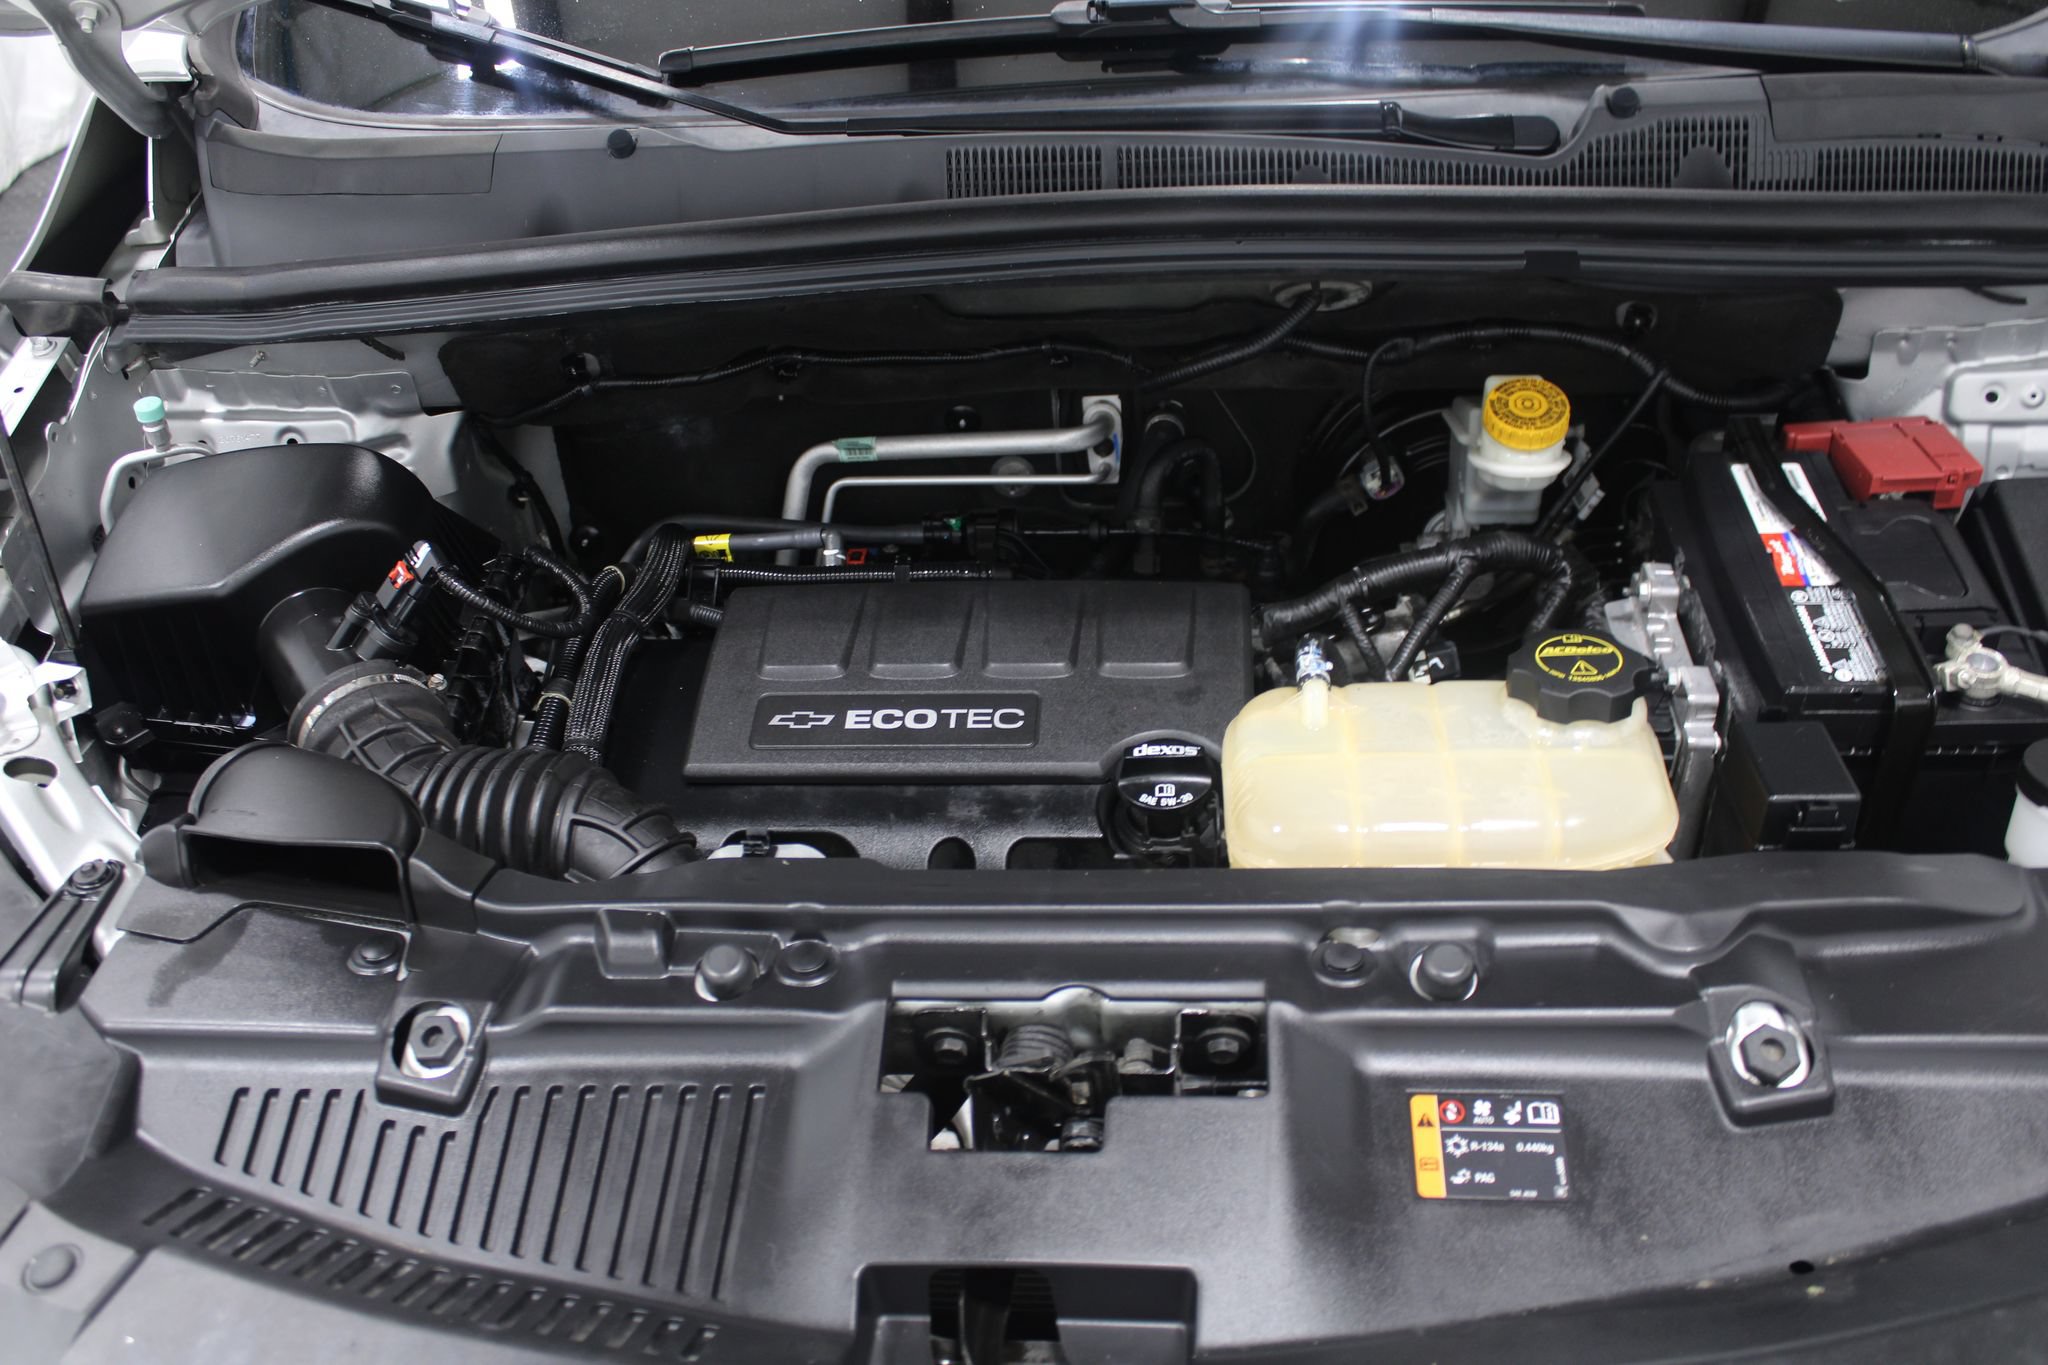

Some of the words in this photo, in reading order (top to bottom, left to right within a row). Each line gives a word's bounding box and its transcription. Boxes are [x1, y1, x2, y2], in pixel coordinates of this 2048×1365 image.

[1539, 645, 1616, 657] ACDelco
[844, 708, 1025, 730] ECOTEC
[1133, 743, 1198, 757] dexos
[1139, 793, 1158, 806] SAE
